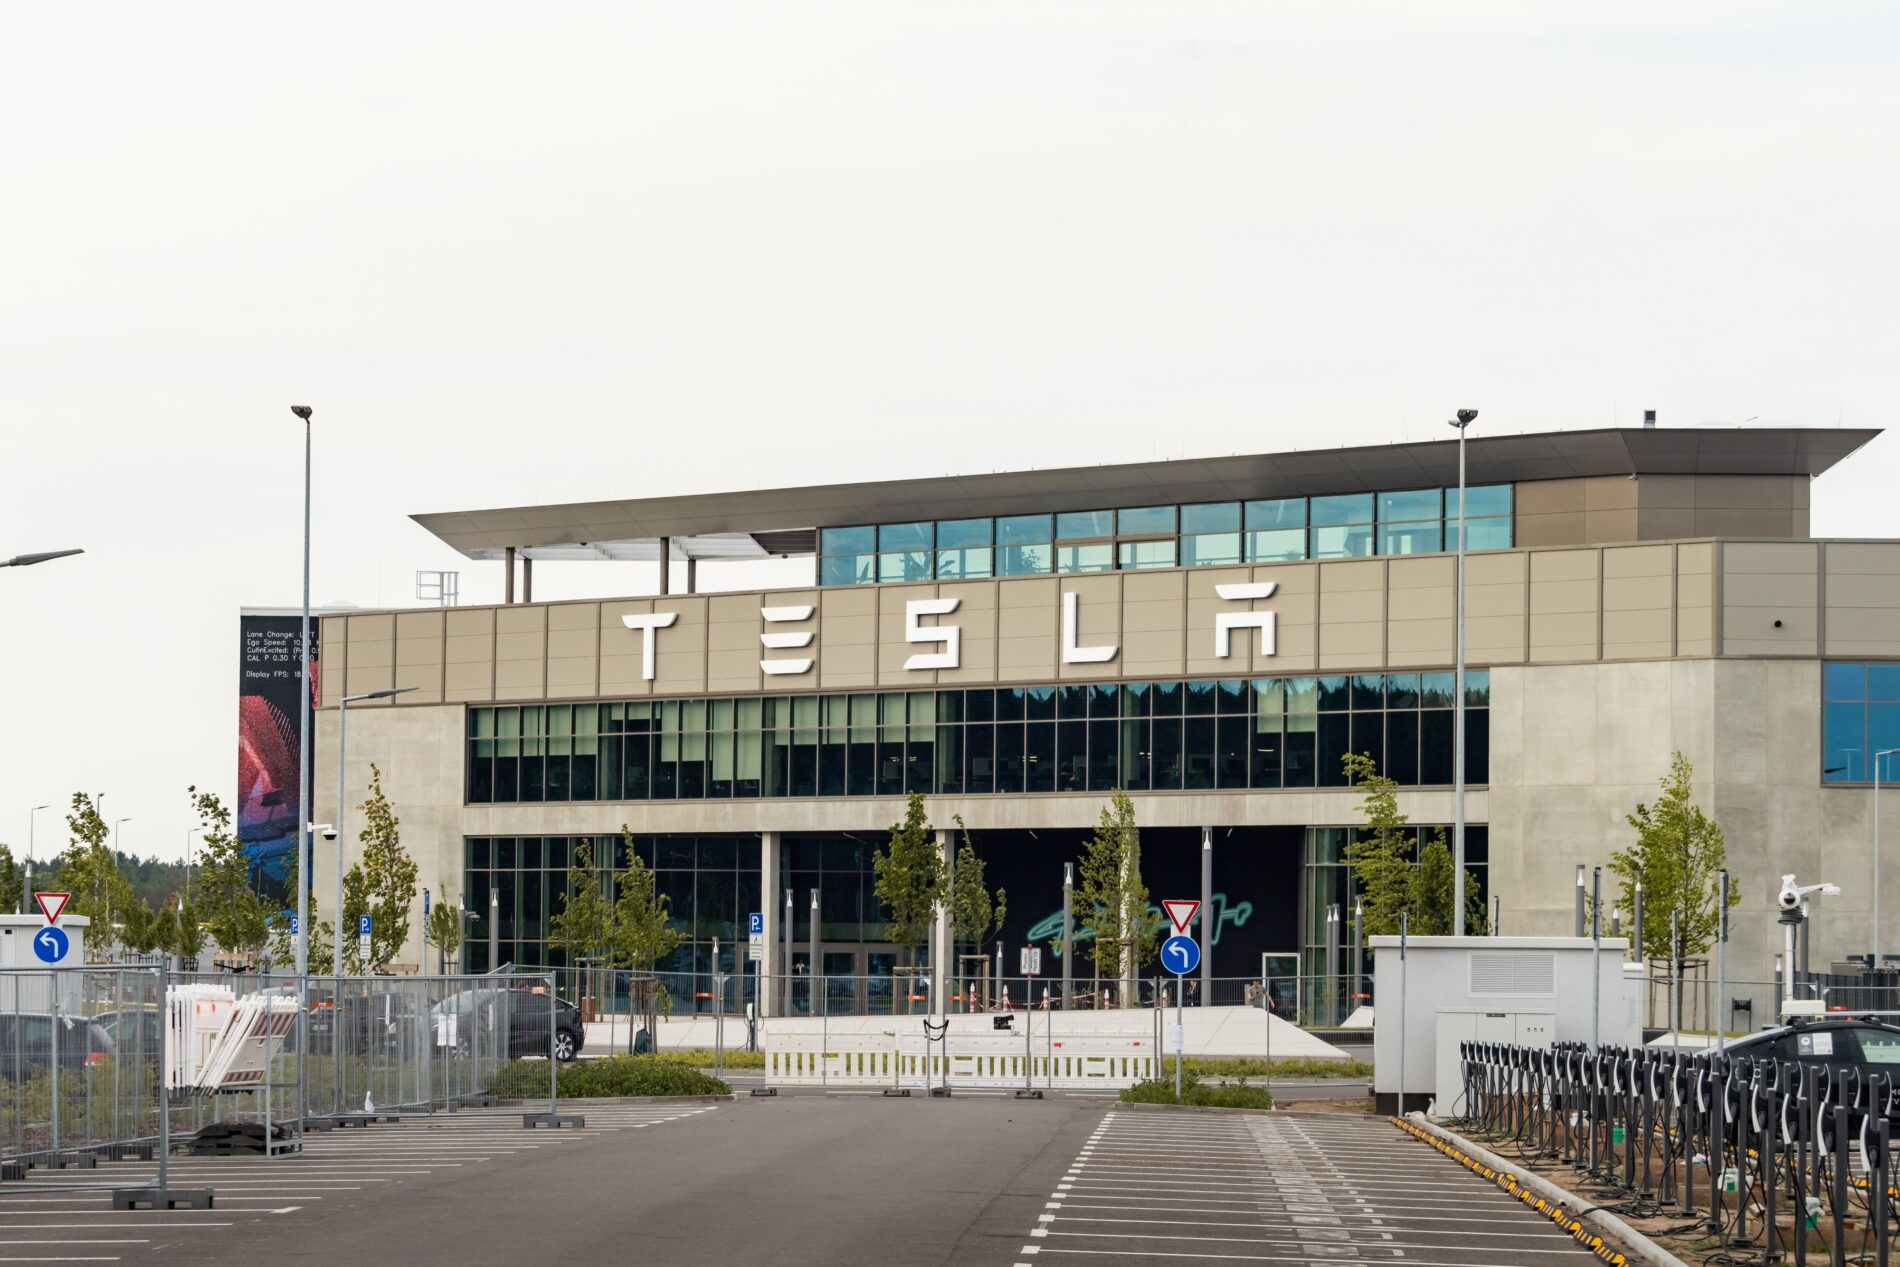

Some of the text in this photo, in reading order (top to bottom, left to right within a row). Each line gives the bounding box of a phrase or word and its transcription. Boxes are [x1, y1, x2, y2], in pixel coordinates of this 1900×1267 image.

[267, 631, 294, 639] Change:
[622, 581, 1278, 681] TESLA
[247, 639, 260, 647] Ego
[246, 670, 270, 679] Display
[361, 917, 369, 932] P
[752, 916, 759, 931] P
